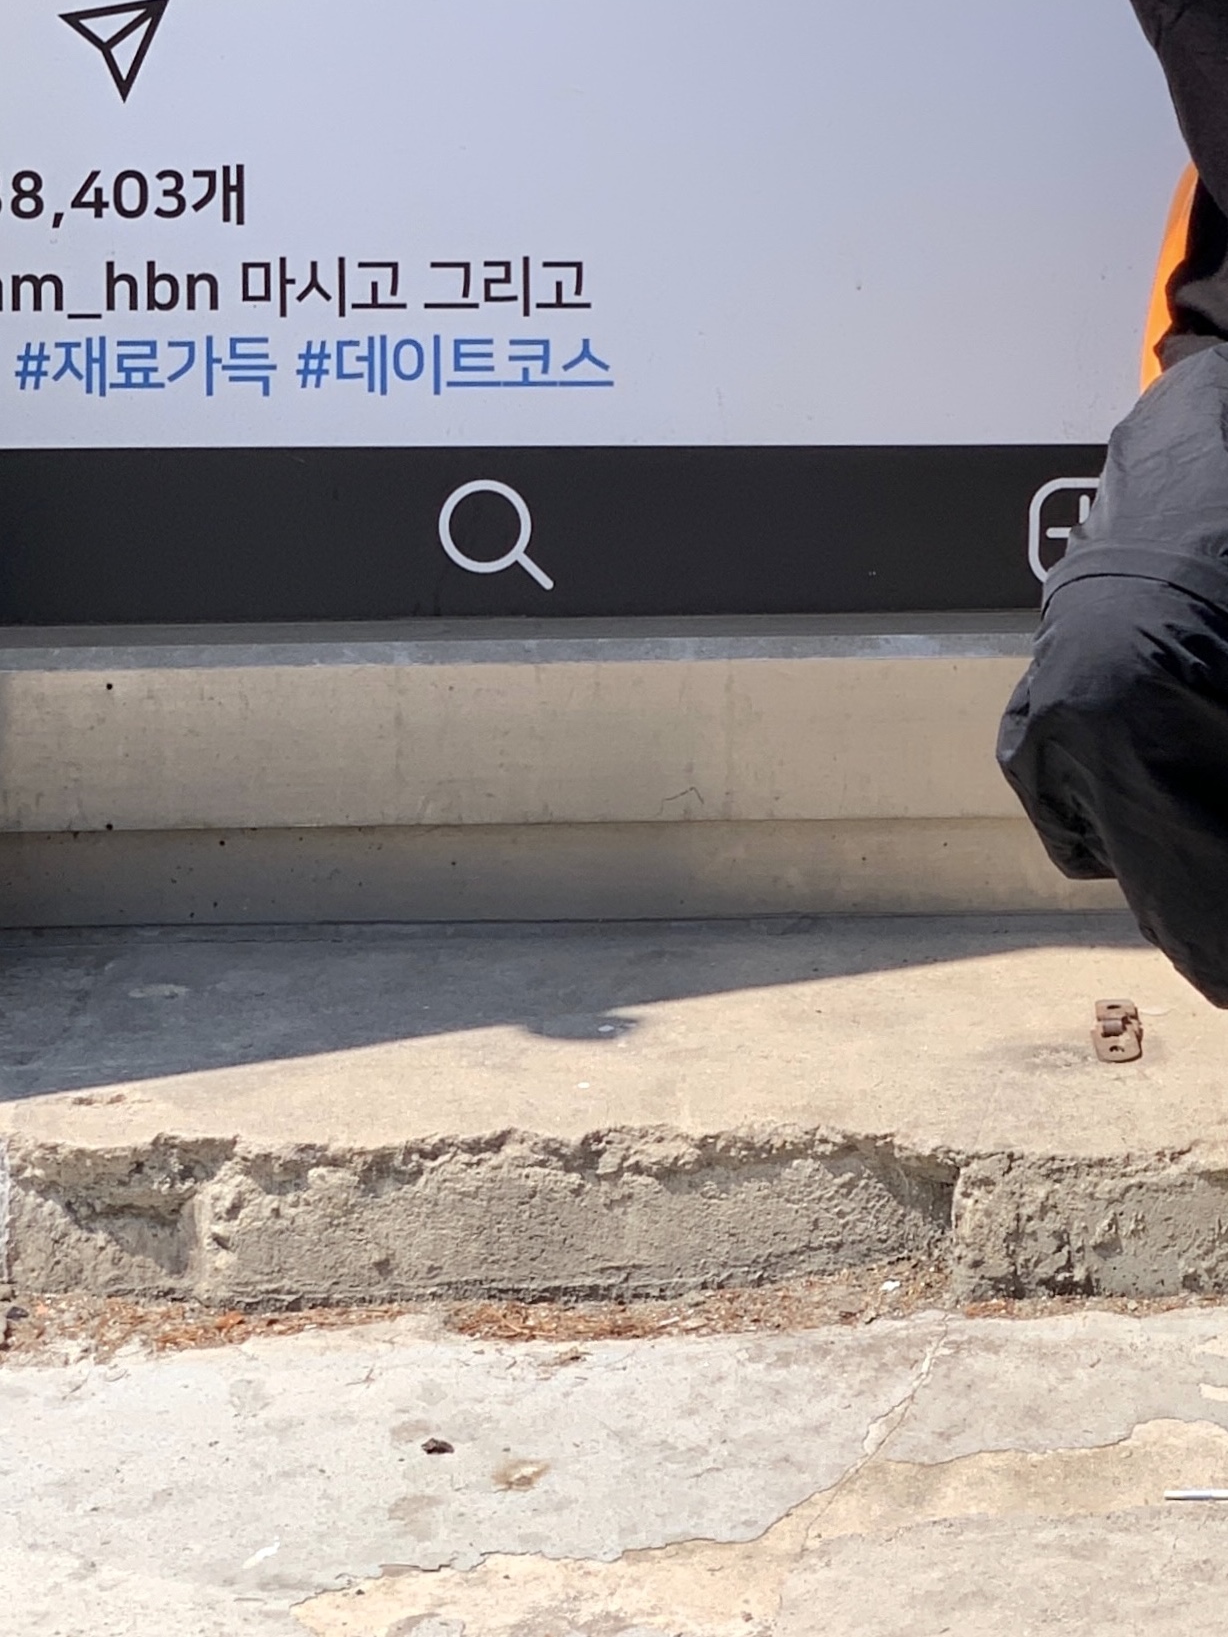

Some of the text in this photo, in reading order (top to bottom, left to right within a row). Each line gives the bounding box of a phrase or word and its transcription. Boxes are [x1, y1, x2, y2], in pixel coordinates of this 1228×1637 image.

[0, 163, 246, 229] 8,403개
[0, 256, 592, 320] m_hbn 마시고 그리고
[14, 334, 615, 397] #재료가득 #데이트코스
